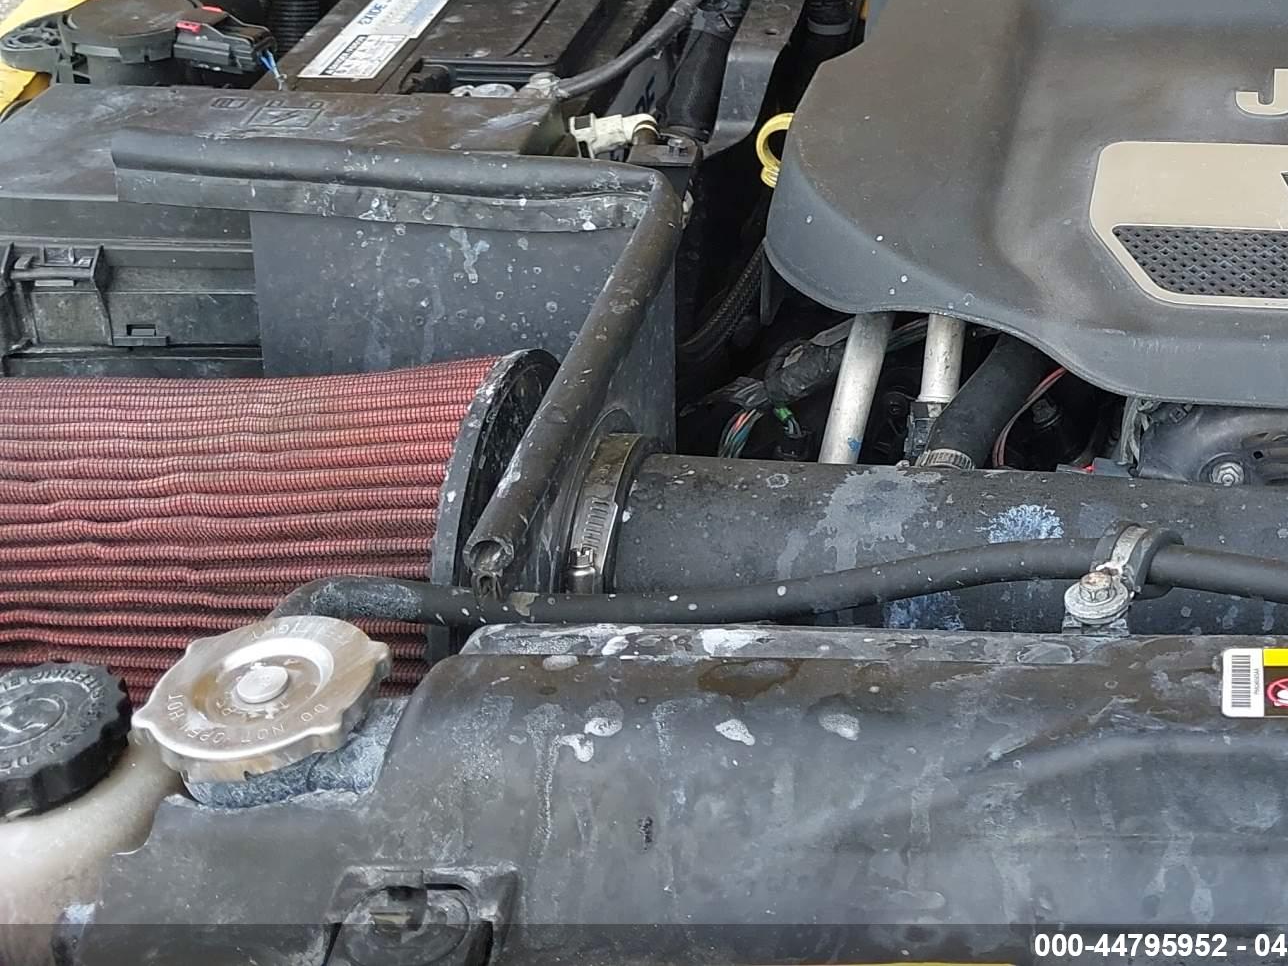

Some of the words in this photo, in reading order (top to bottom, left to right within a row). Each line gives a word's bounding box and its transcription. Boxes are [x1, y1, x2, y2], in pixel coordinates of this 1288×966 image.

[167, 694, 185, 721] HOT
[300, 703, 329, 722] DO
[240, 723, 285, 745] NOT
